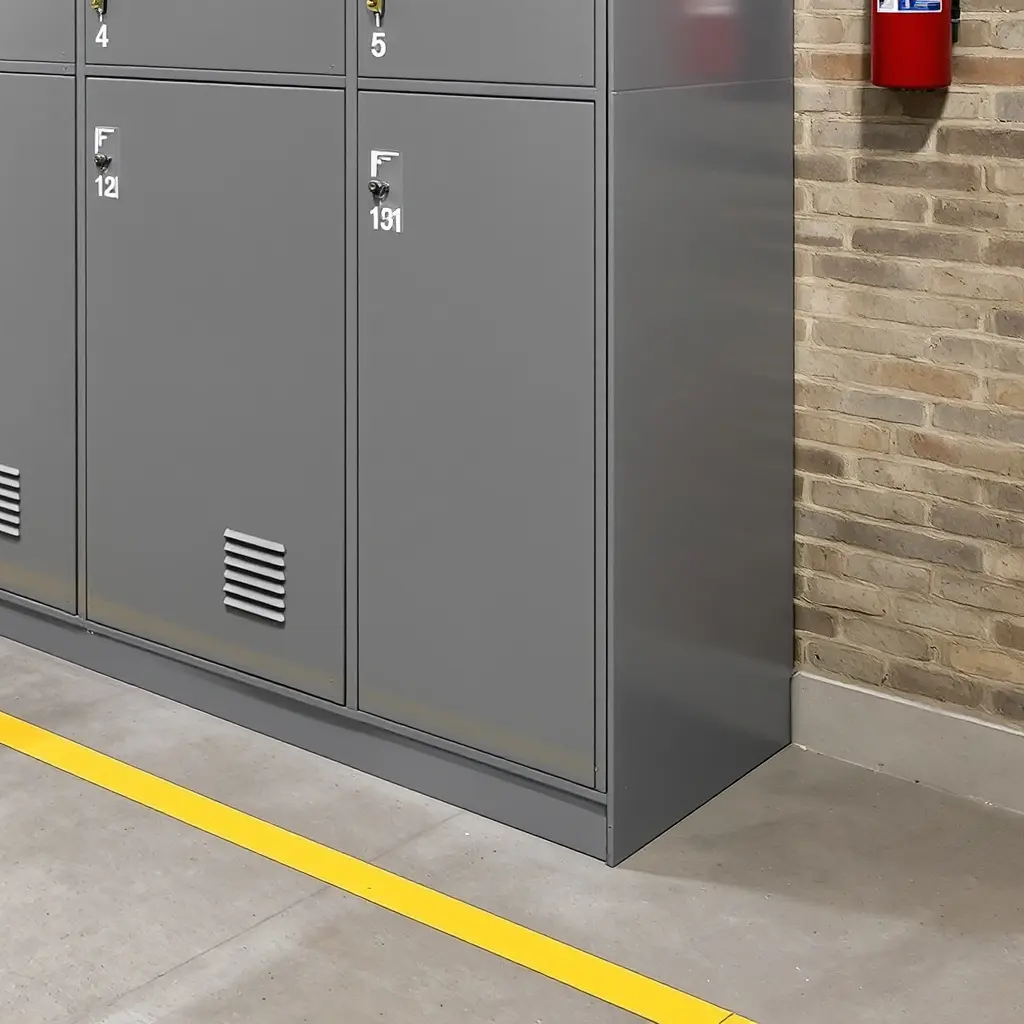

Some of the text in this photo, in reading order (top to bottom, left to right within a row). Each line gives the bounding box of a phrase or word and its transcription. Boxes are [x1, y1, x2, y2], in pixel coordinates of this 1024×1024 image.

[95, 23, 109, 48] 4
[371, 32, 387, 58] 5
[94, 127, 115, 154] F
[371, 150, 400, 178] F
